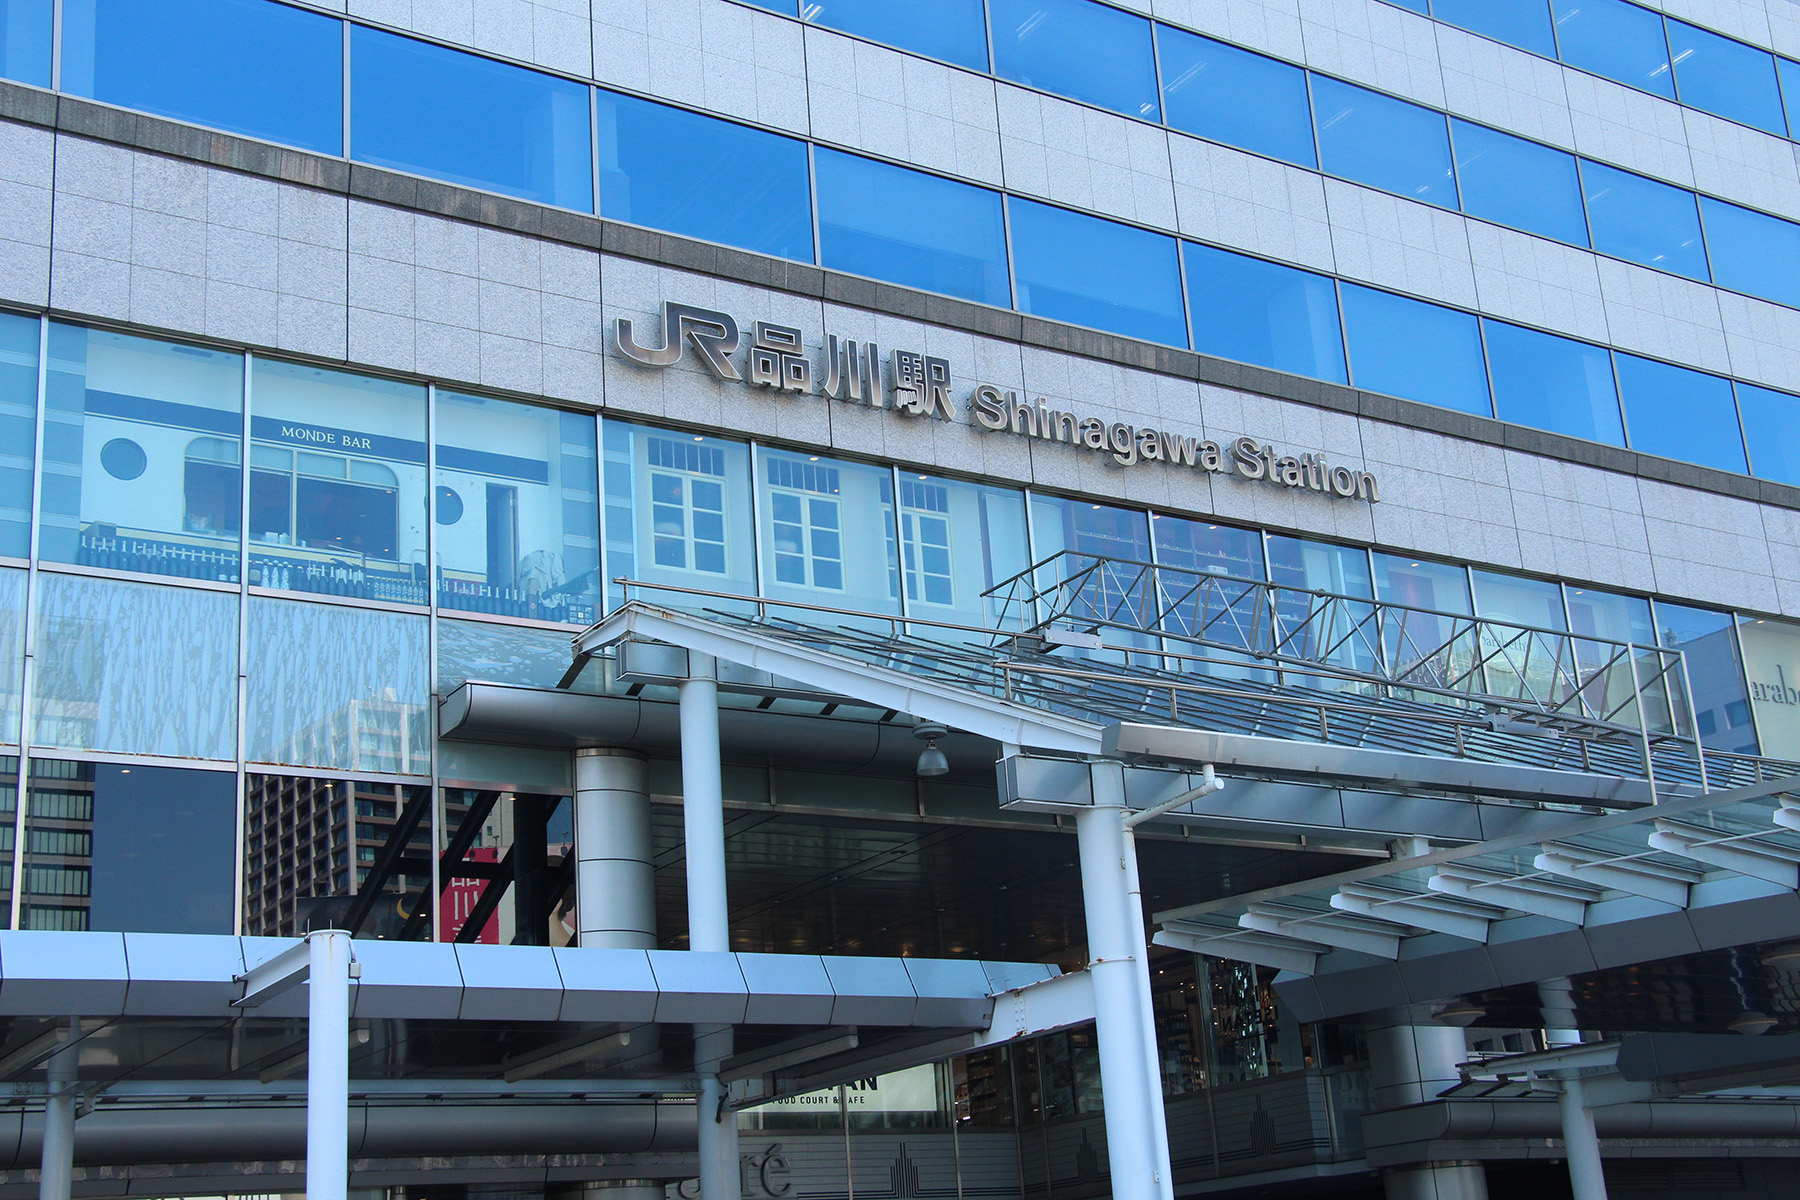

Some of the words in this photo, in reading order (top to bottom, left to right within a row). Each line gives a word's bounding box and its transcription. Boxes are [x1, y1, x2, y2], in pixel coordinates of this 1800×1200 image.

[612, 300, 957, 423] JR品川駅
[281, 425, 336, 444] MONDE
[342, 435, 371, 449] BAR
[969, 383, 1223, 474] Shinagawa
[1230, 436, 1380, 503] Station
[1750, 664, 1800, 706] arab
[773, 1096, 796, 1105] OOD
[800, 1096, 828, 1104] COURT
[833, 1096, 839, 1104] &
[845, 1096, 865, 1104] AFE
